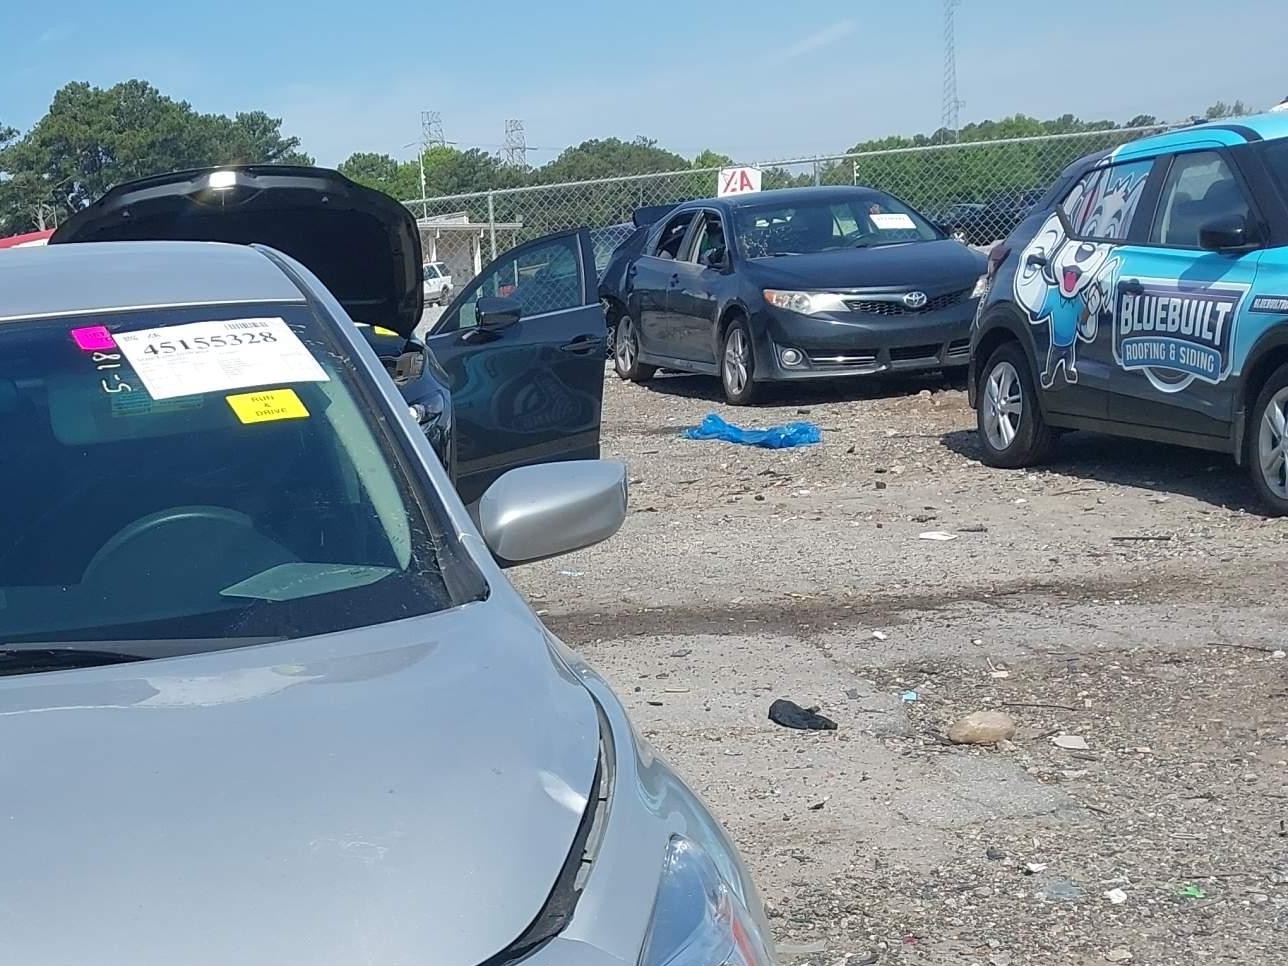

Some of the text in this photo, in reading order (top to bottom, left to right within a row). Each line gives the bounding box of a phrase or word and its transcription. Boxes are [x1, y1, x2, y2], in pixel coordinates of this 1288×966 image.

[1120, 294, 1233, 346] BLUEBUILT
[144, 331, 278, 355] 45155328
[1125, 342, 1214, 373] ROOFING & SIDING
[92, 352, 132, 393] 5-18
[255, 408, 287, 417] DRIVE
